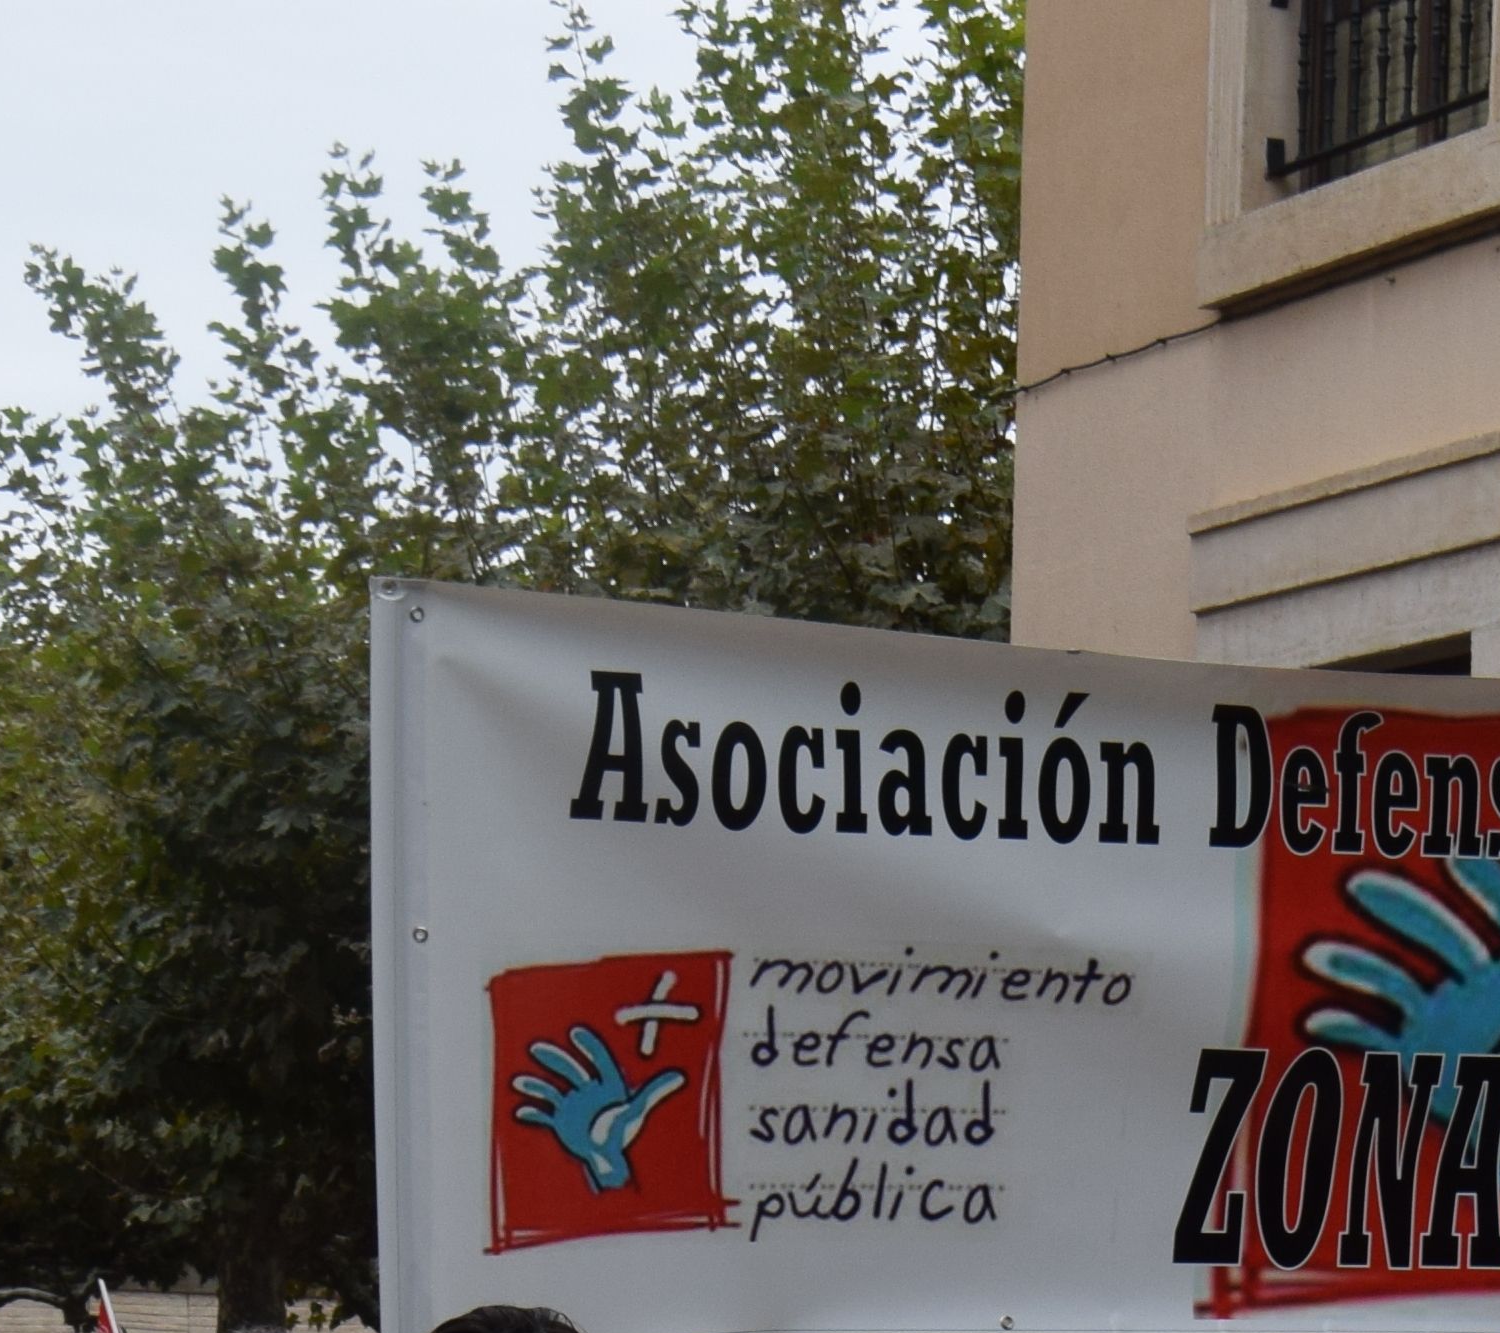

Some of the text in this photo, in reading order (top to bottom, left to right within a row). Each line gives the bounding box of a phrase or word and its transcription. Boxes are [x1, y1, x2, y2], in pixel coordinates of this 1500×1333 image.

[570, 670, 1160, 846] Asociación
[750, 946, 1132, 1006] movimiento
[751, 1004, 1000, 1070] defensa
[750, 1078, 995, 1147] sanidad
[750, 1157, 998, 1242] pública
